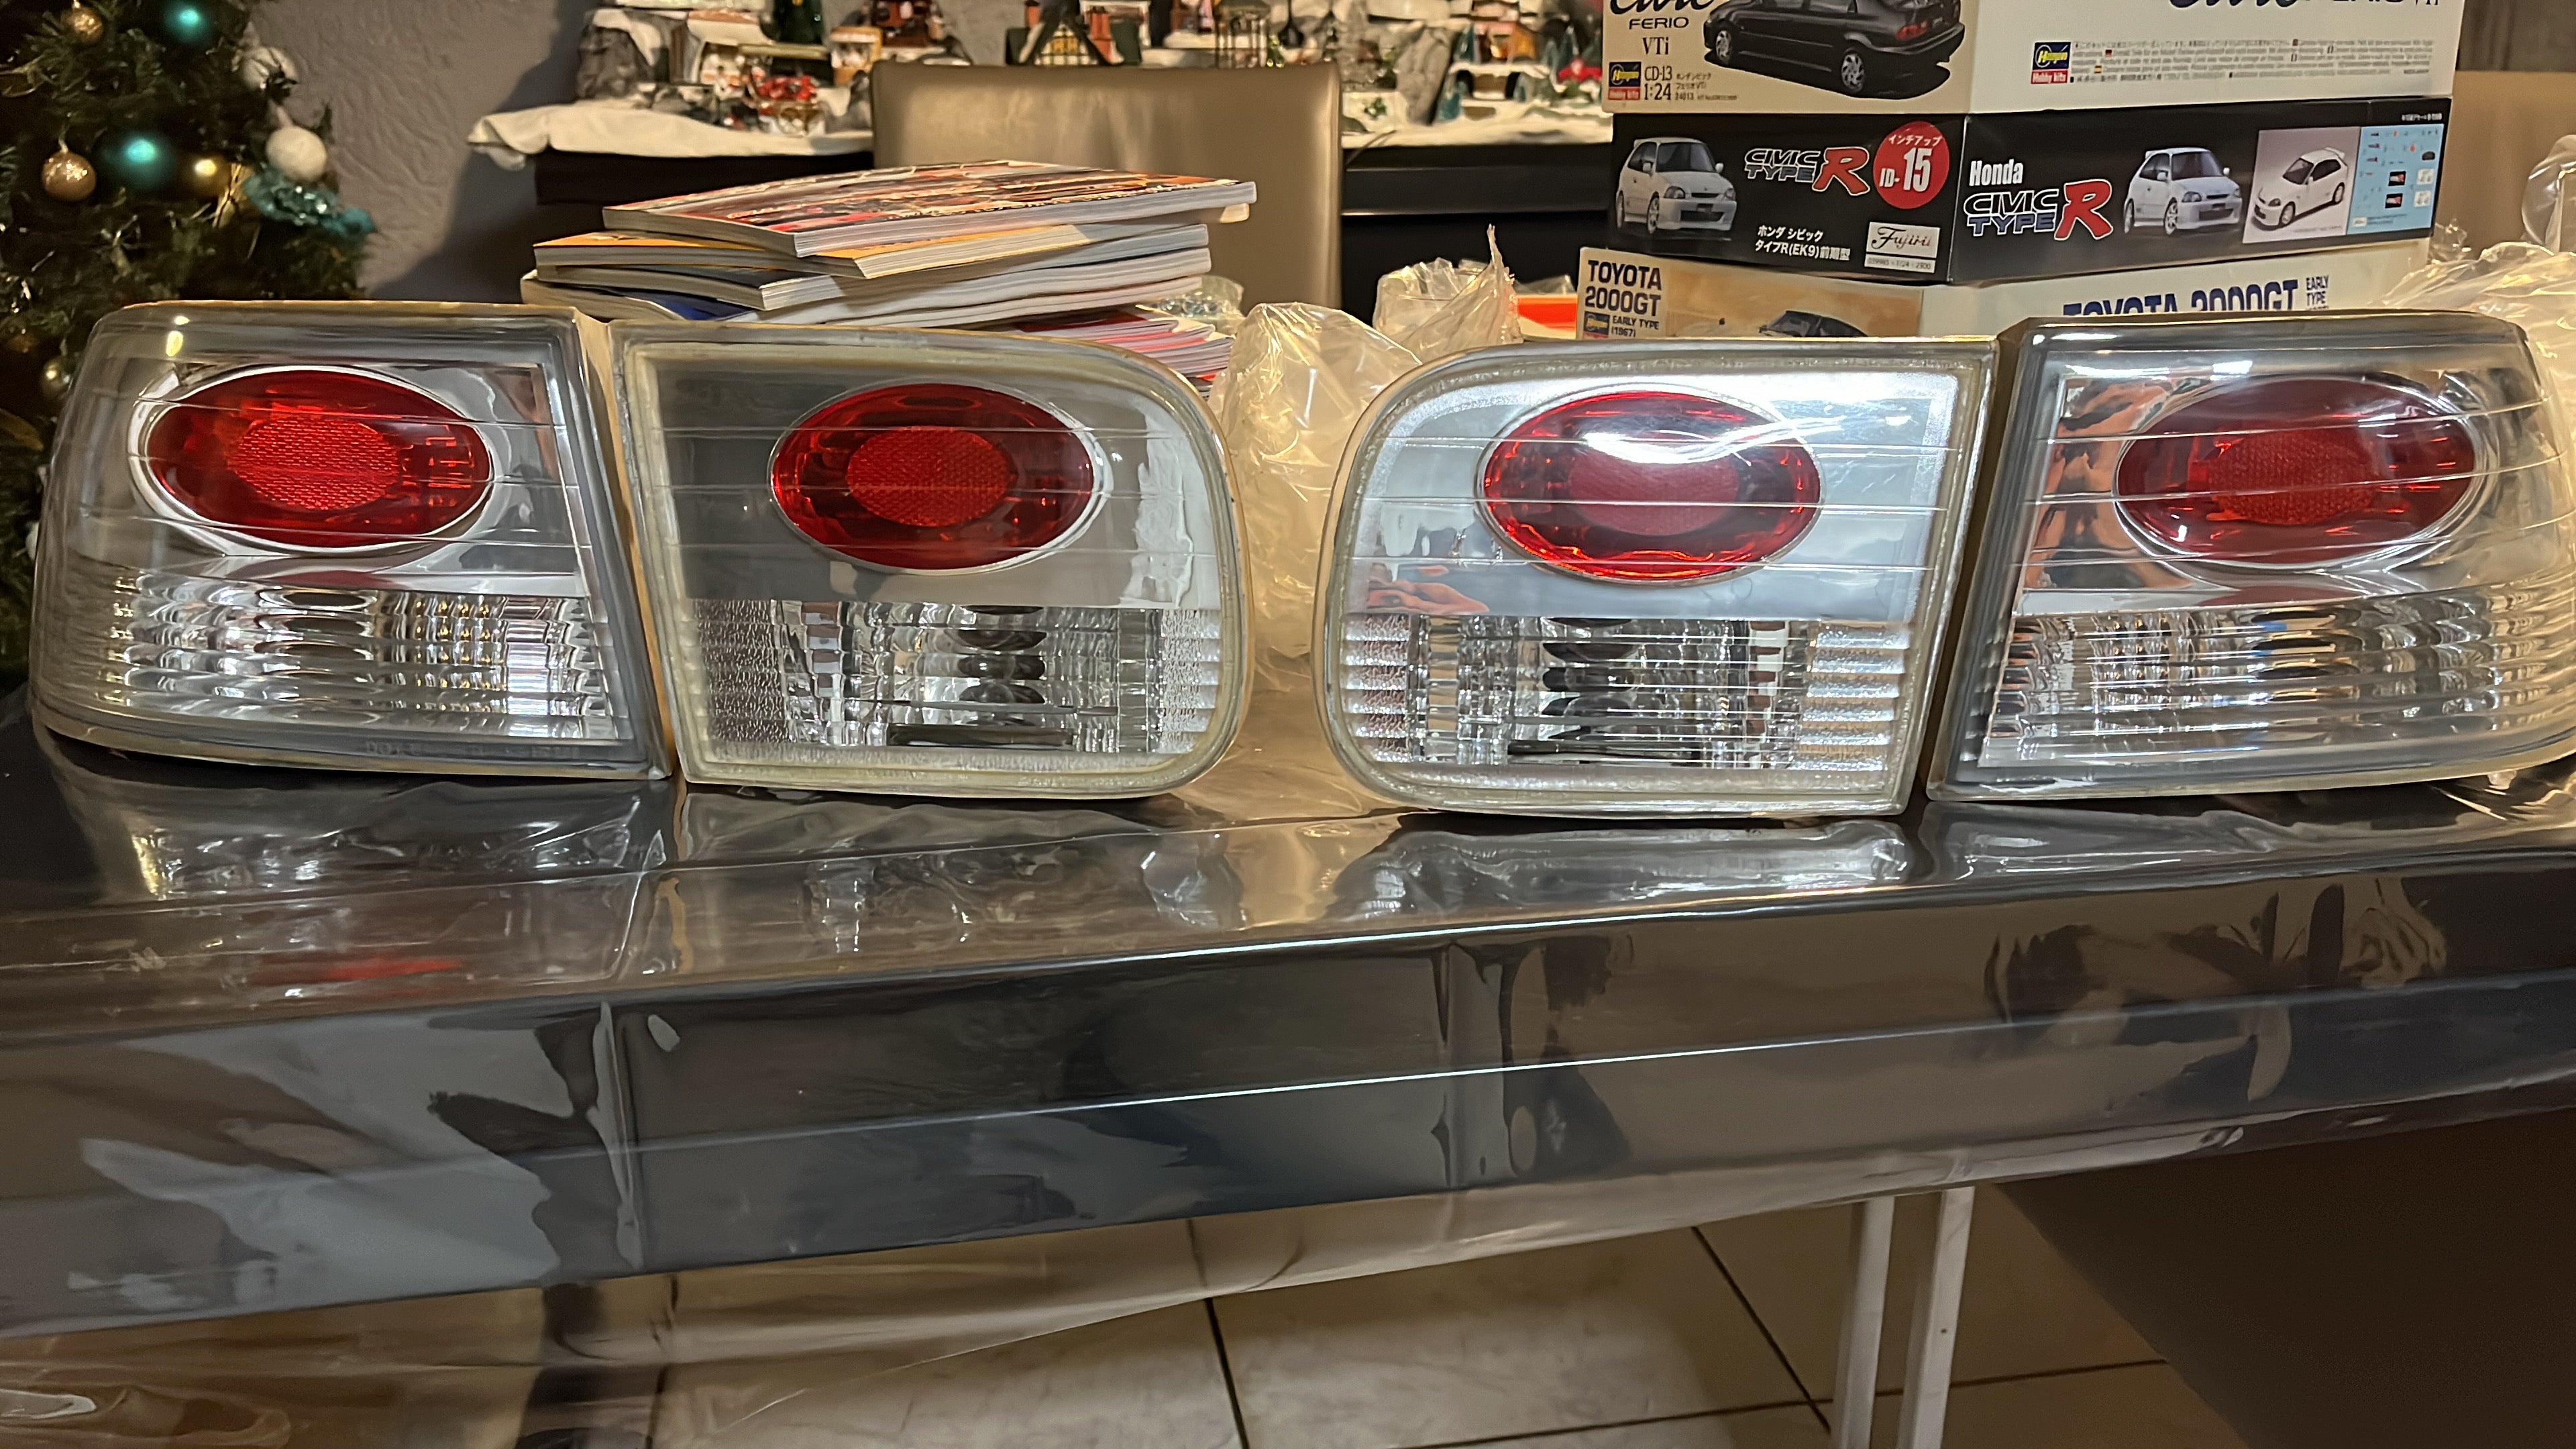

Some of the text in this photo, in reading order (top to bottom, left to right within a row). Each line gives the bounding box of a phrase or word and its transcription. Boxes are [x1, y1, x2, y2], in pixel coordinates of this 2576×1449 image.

[1629, 17, 1689, 30] FERIO
[1643, 36, 1669, 55] VTi
[1644, 66, 1672, 81] CD-13
[1644, 83, 1672, 101] 1:24
[1888, 134, 1943, 147] インチアップ
[1744, 148, 1821, 167] CIVIC
[1744, 146, 1871, 197] TYPE R
[1969, 159, 2024, 186] Honda
[1964, 188, 2059, 217] CIVIC
[1967, 178, 2113, 241] TYPE R
[1758, 225, 1824, 242] ホンダ シビック
[1588, 260, 1662, 291] TOYOTA
[2306, 276, 2329, 290] EARLY
[1585, 286, 1662, 317] 2000GT
[2307, 291, 2326, 307] TYPE
[1613, 315, 1637, 327] EARLY
[1639, 319, 1660, 330] TYPE
